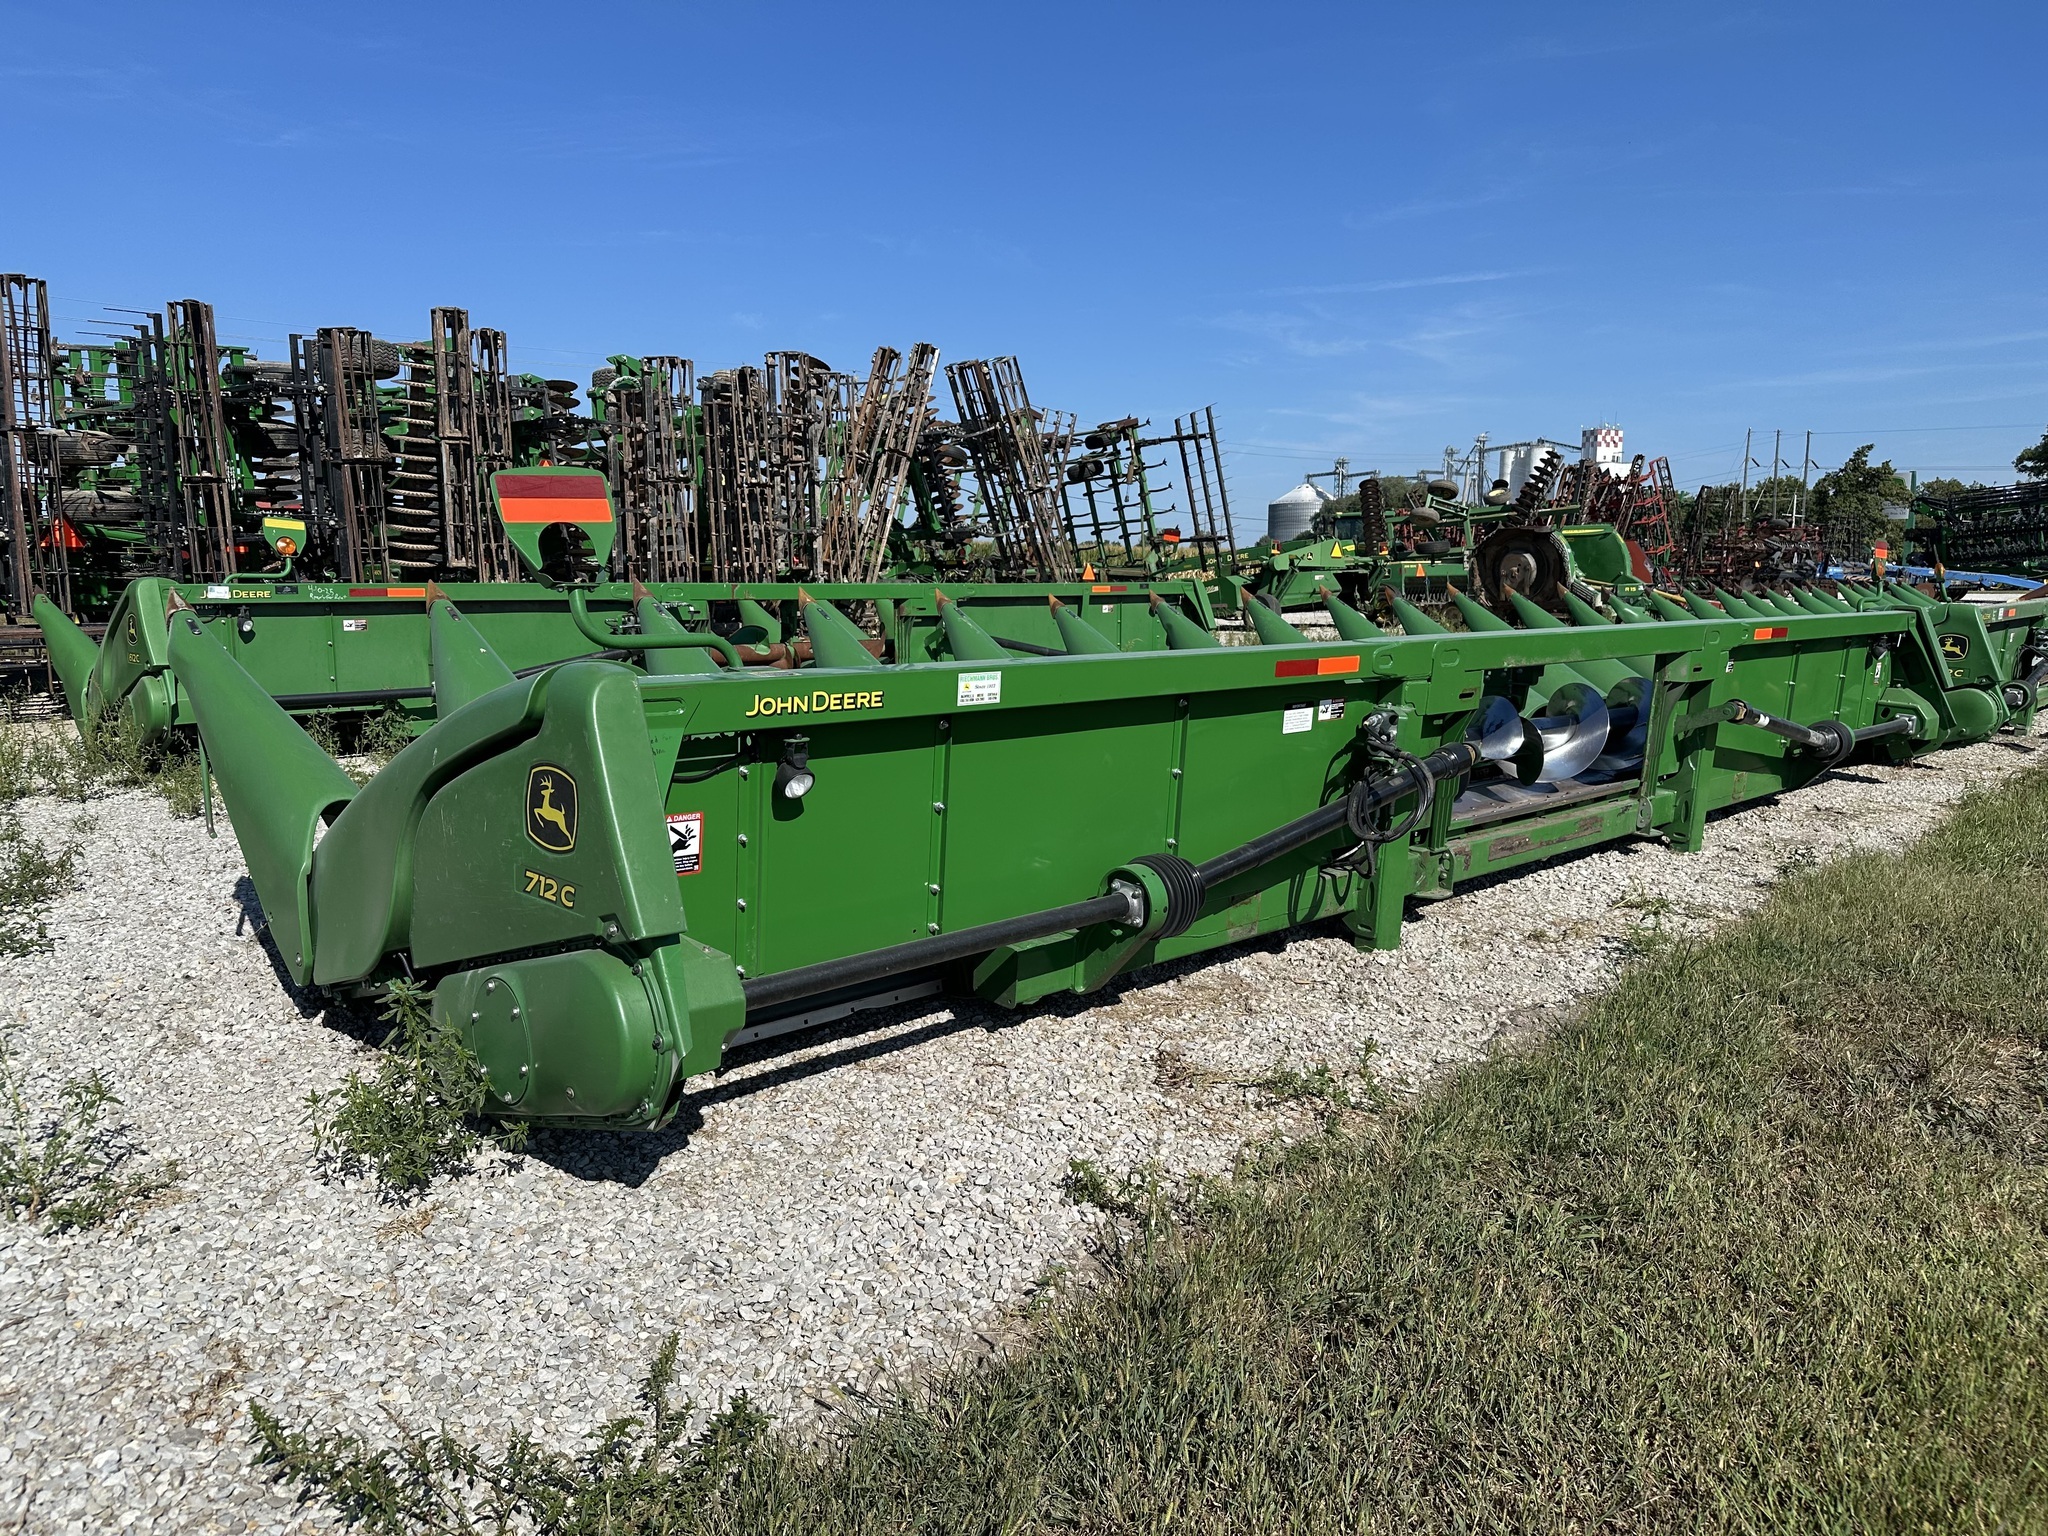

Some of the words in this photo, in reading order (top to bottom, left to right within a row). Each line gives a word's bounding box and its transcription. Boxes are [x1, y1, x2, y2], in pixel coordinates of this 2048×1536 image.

[232, 589, 271, 598] DEERE
[745, 694, 809, 717] JOHN
[811, 690, 884, 713] DEERE
[673, 813, 701, 822] DANGER
[525, 870, 576, 908] 712C
